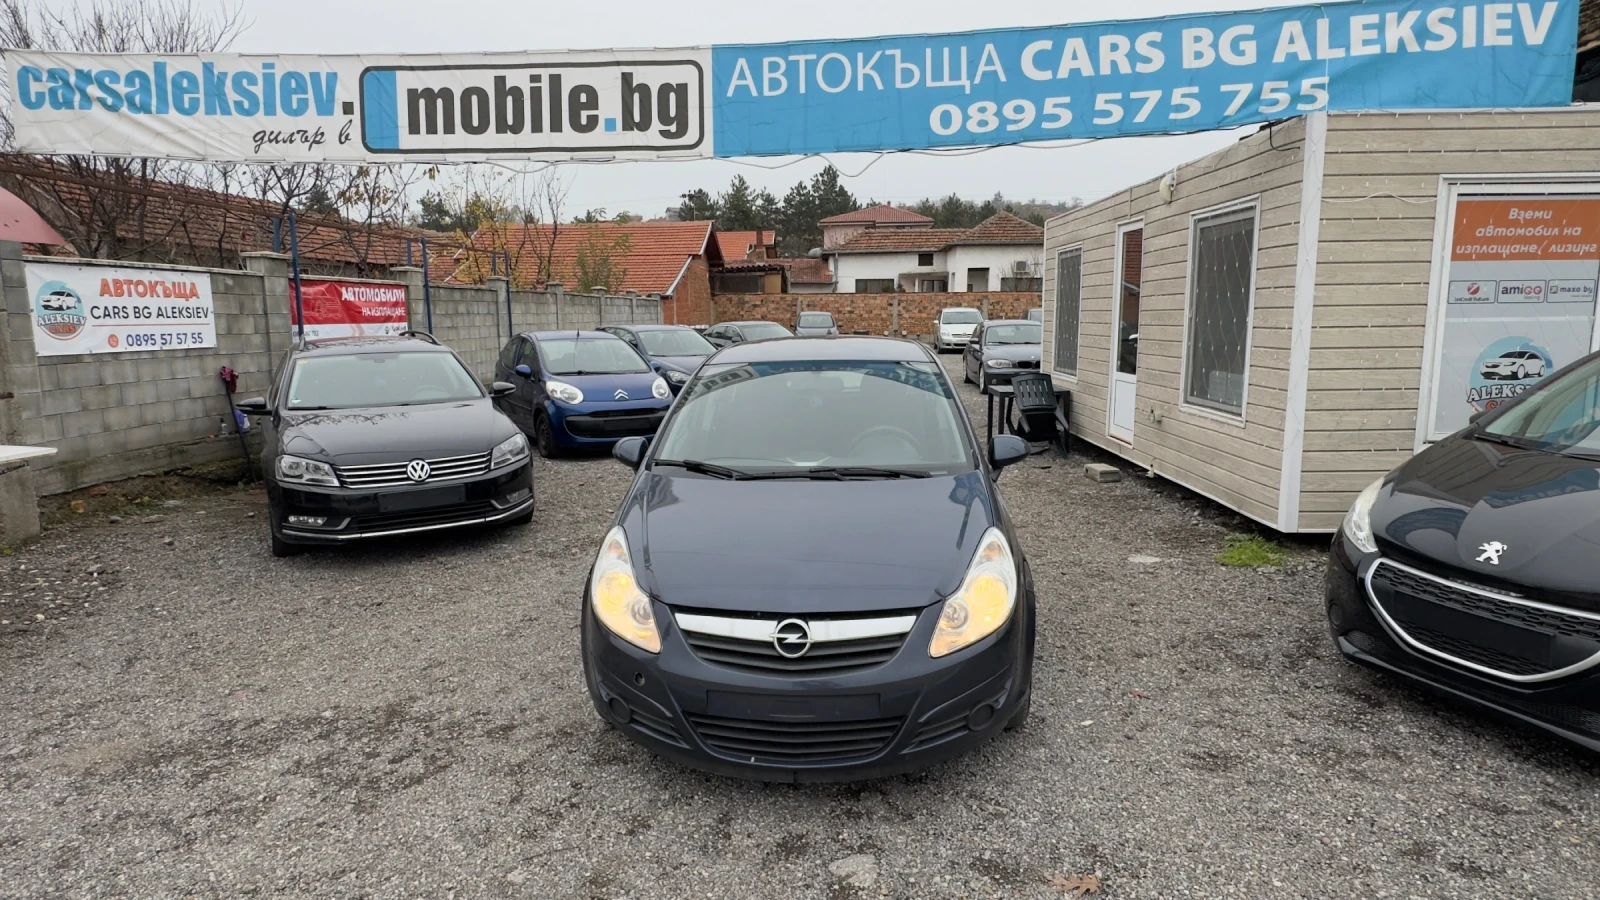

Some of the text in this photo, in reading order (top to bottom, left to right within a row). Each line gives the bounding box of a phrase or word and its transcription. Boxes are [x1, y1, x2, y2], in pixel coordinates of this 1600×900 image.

[1020, 1, 1559, 81] CARS BG ALEKSIEV
[726, 43, 1006, 97] АВТОКЪЩА
[407, 72, 689, 139] mobile.bg
[929, 76, 1330, 135] 0895 575 755
[253, 119, 354, 154] дилър в
[1508, 208, 1552, 220] Вземи
[1475, 225, 1582, 237] автомобил на
[1548, 243, 1597, 254] лизинг
[99, 278, 200, 301] АВТОКЪЩА
[341, 286, 405, 302] АВТОМОБИЛИ
[37, 313, 87, 327] ALEKSIEV
[90, 305, 209, 319] CARS BG ALEKSIEV
[50, 324, 77, 334] CARS
[126, 332, 204, 347] 0895 57 57 55
[1467, 384, 1532, 403] ALEKS
